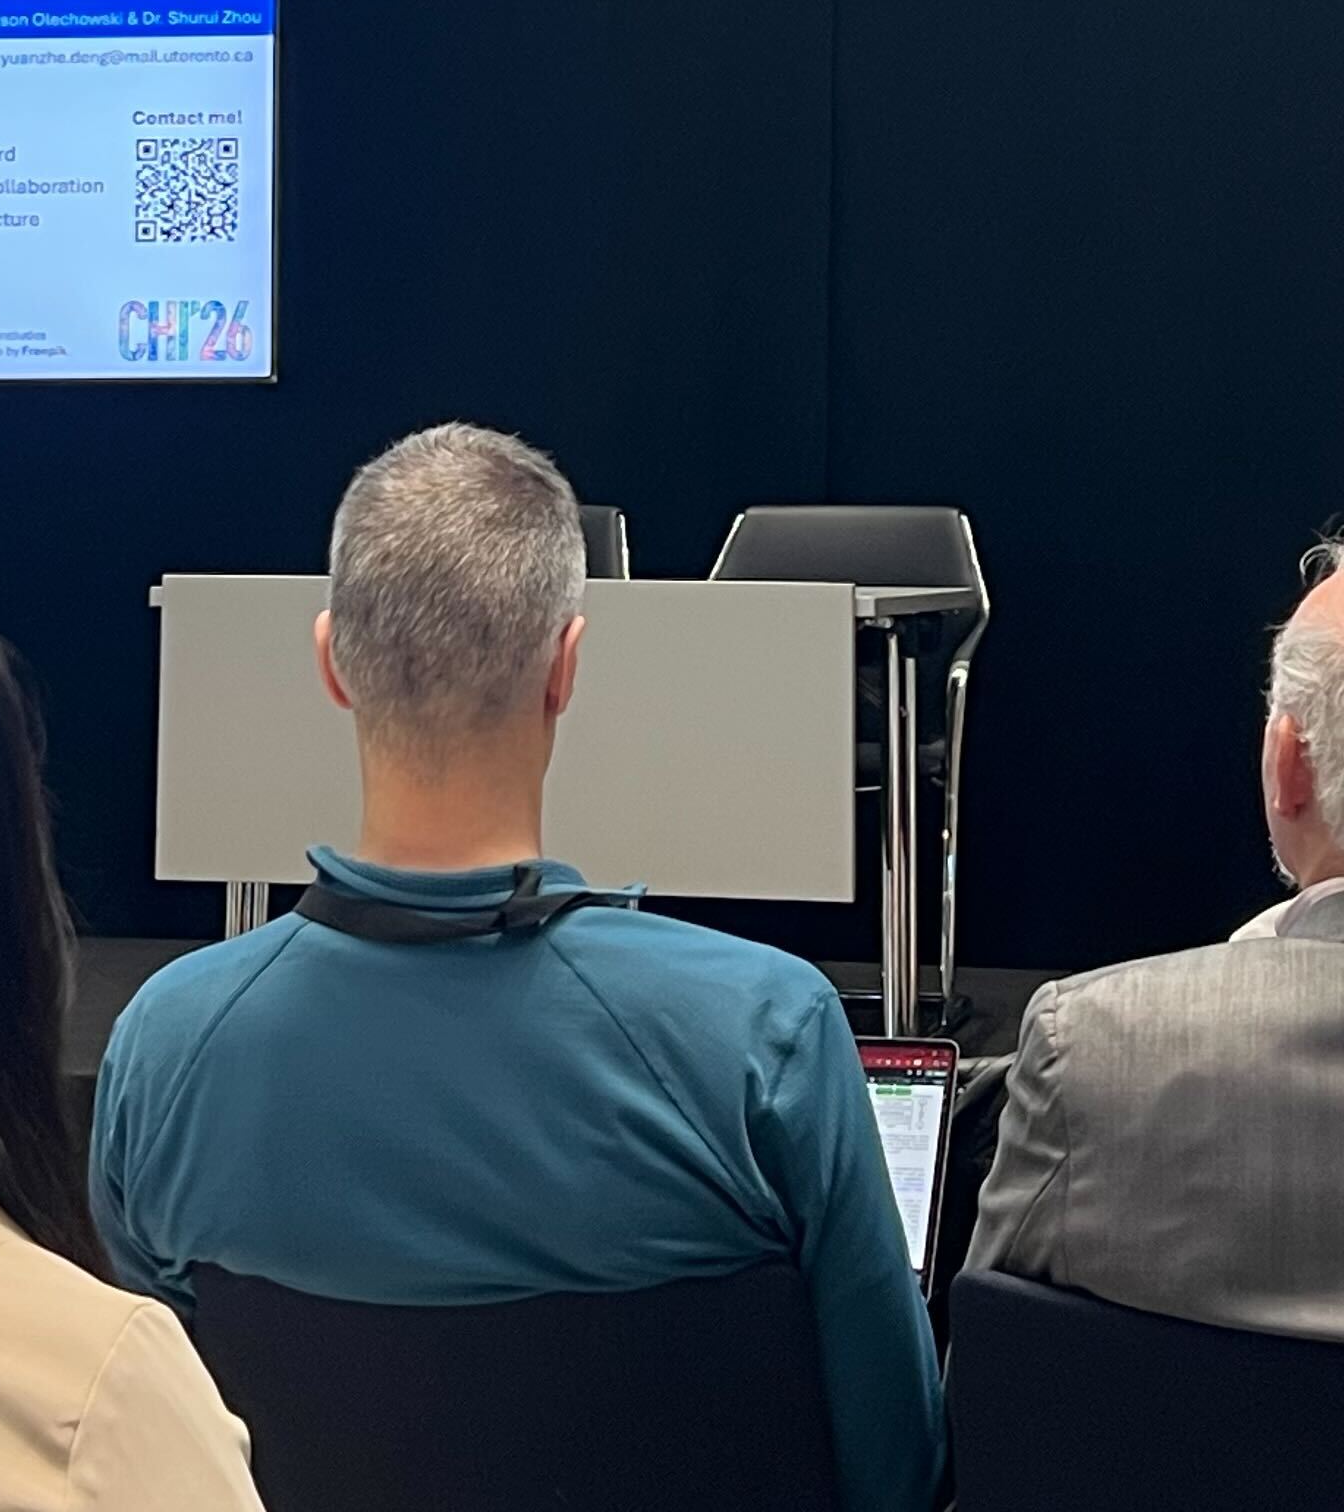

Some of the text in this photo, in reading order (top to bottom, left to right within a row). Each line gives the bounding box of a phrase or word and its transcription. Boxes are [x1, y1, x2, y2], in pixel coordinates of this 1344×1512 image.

[32, 12, 123, 26] Olechowski
[127, 12, 138, 26] &
[168, 10, 219, 25] Shurui
[222, 9, 262, 24] Zhou
[132, 109, 243, 126] Contact me!
